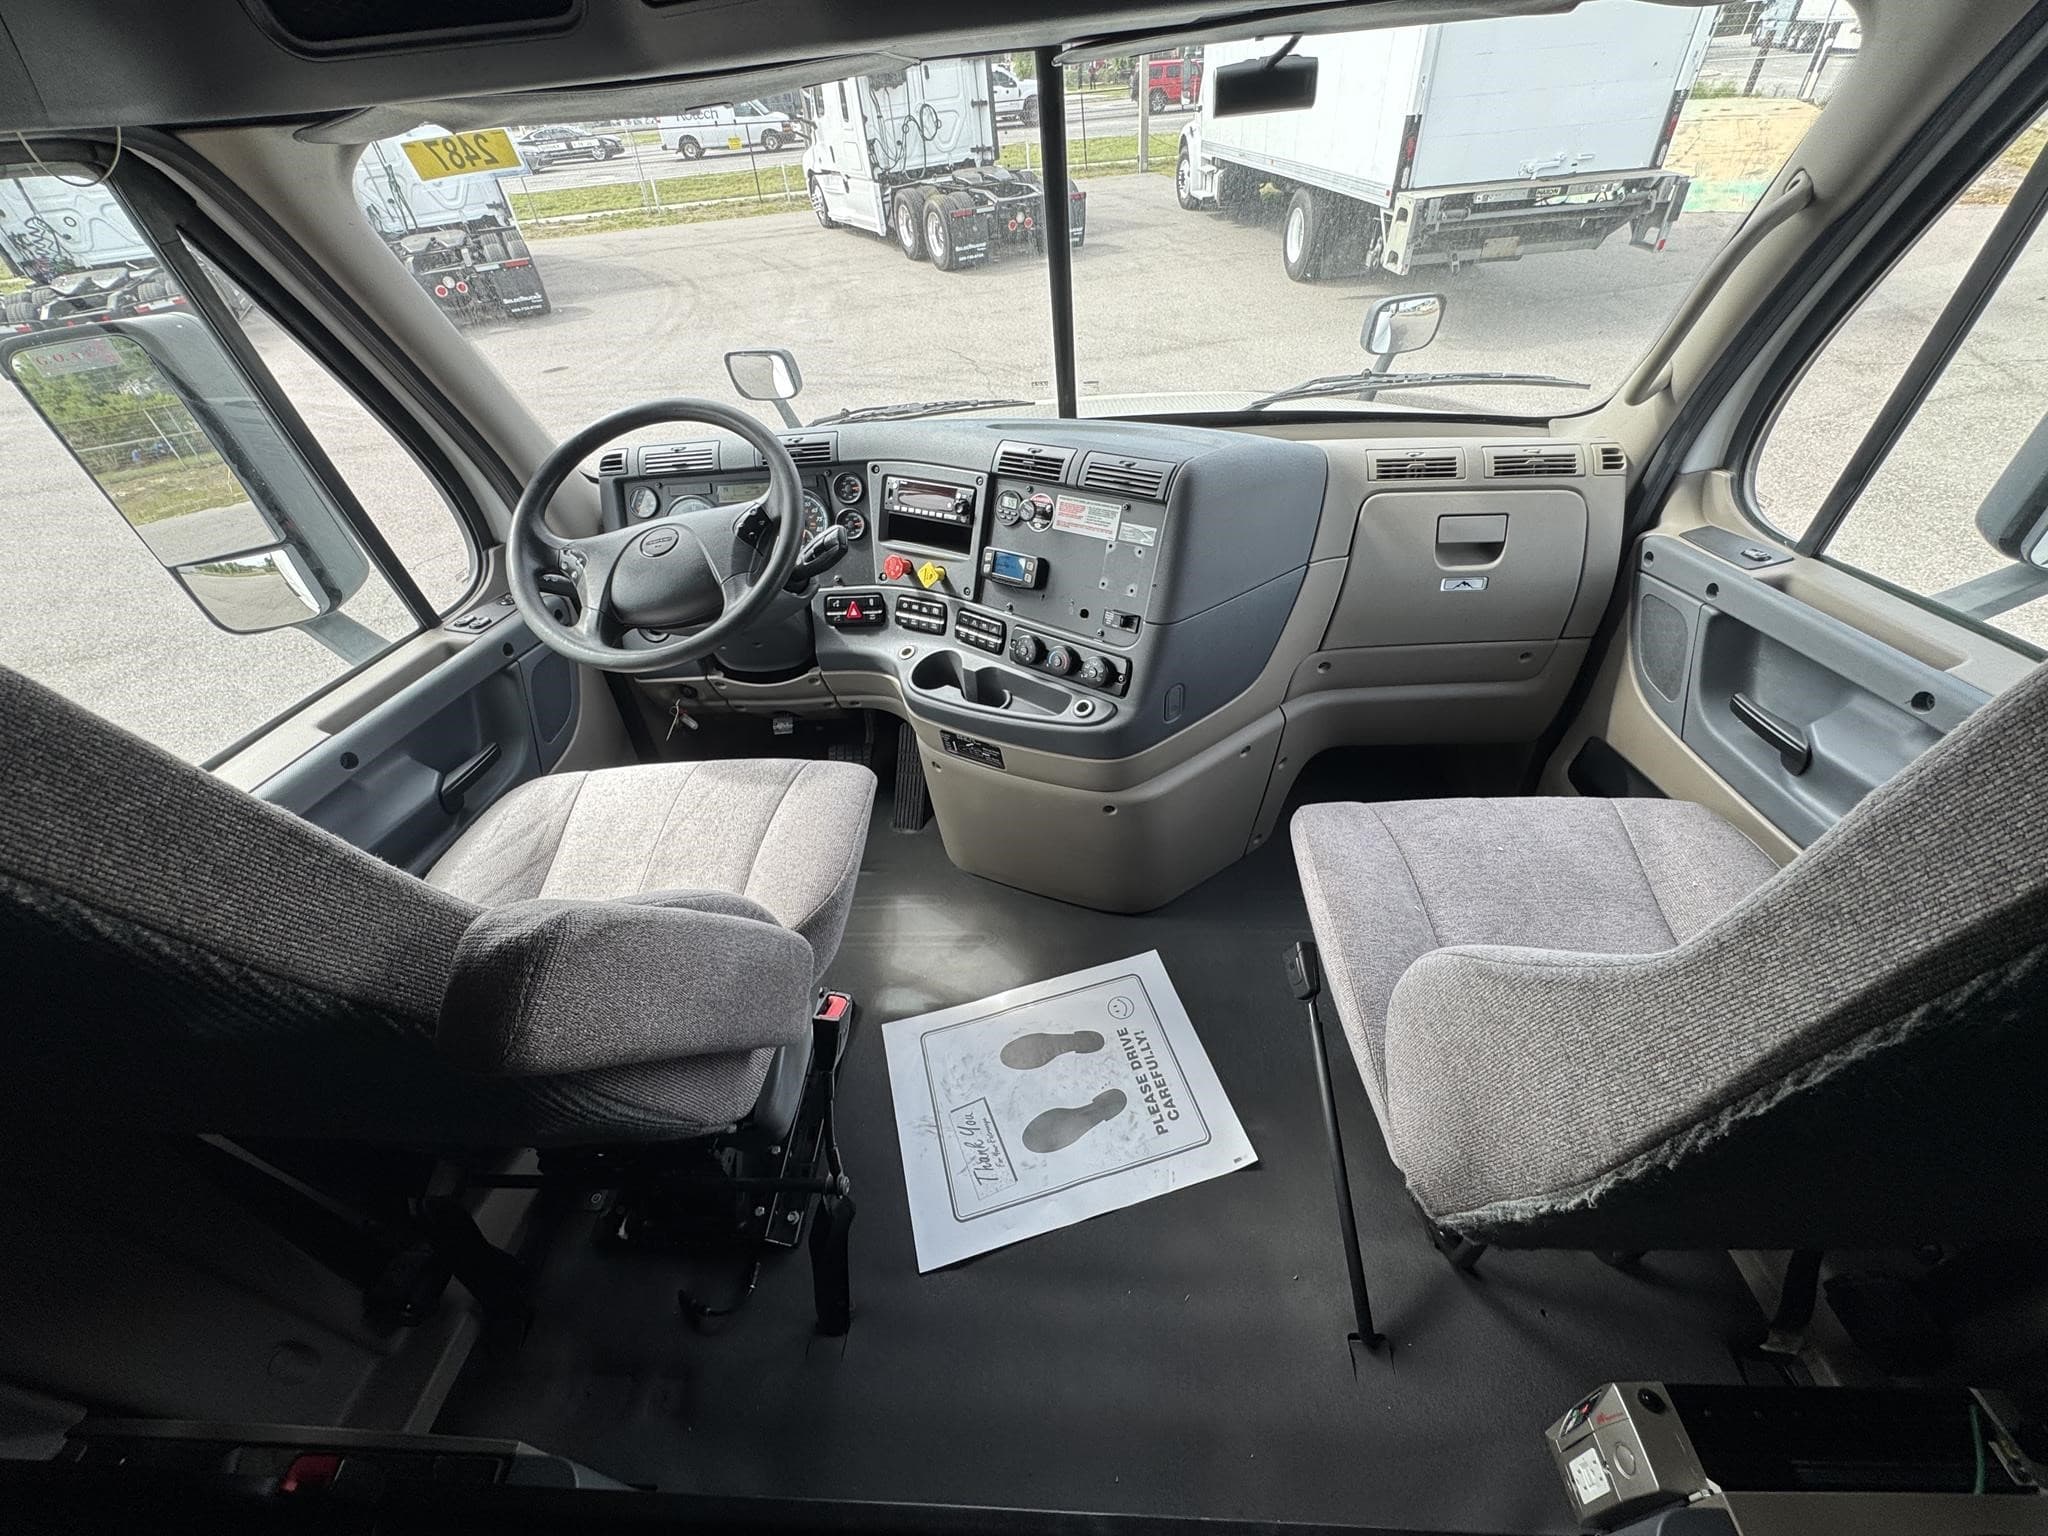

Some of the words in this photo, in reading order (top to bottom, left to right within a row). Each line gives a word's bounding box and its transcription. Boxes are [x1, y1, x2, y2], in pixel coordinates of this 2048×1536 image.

[1117, 1027, 1143, 1071] DRIVE
[1134, 1030, 1180, 1121] CAREFULLY!
[957, 1112, 981, 1136] You
[1135, 1073, 1169, 1136] PLEASE
[964, 1139, 999, 1186] Thank
